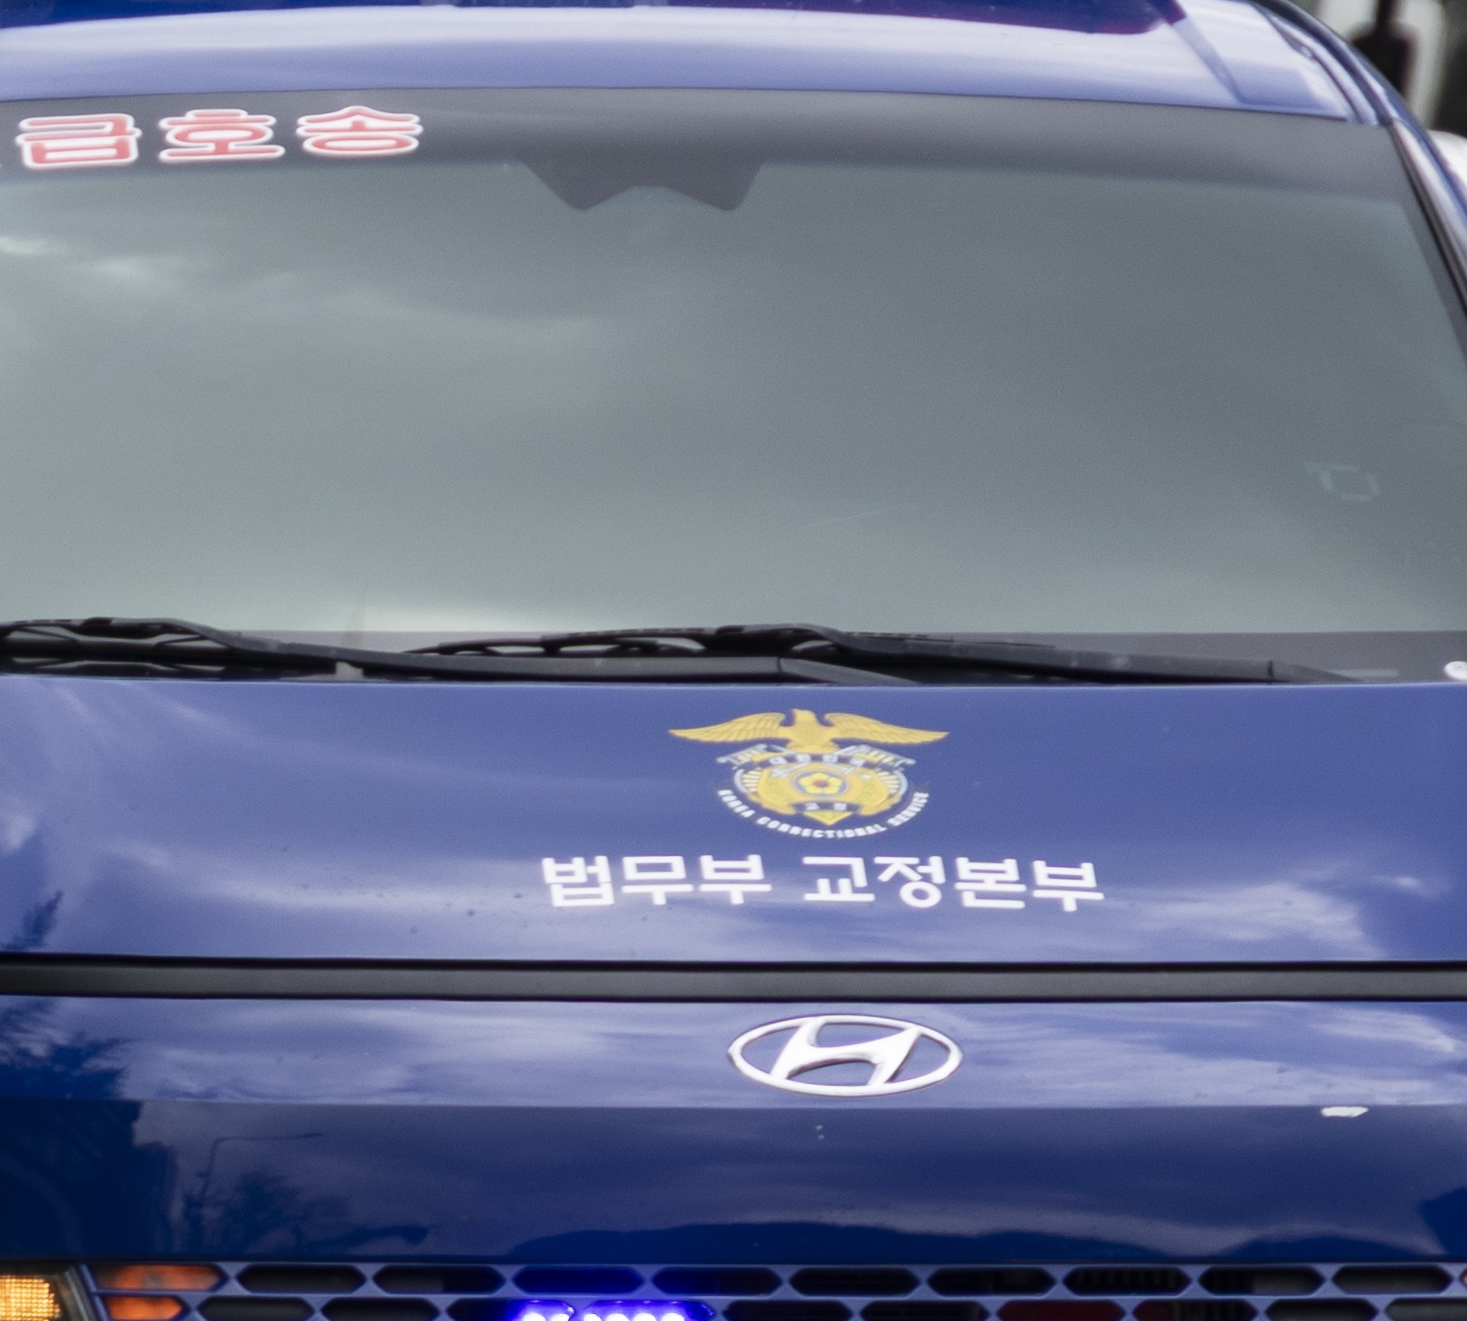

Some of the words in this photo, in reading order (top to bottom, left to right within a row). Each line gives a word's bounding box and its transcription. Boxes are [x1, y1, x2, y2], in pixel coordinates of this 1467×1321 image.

[717, 788, 755, 819] KOREA
[755, 815, 888, 839] CORRECTIONAL
[887, 791, 930, 827] SERVICE
[541, 855, 773, 908] 법무부
[802, 855, 1105, 912] 교정본부
